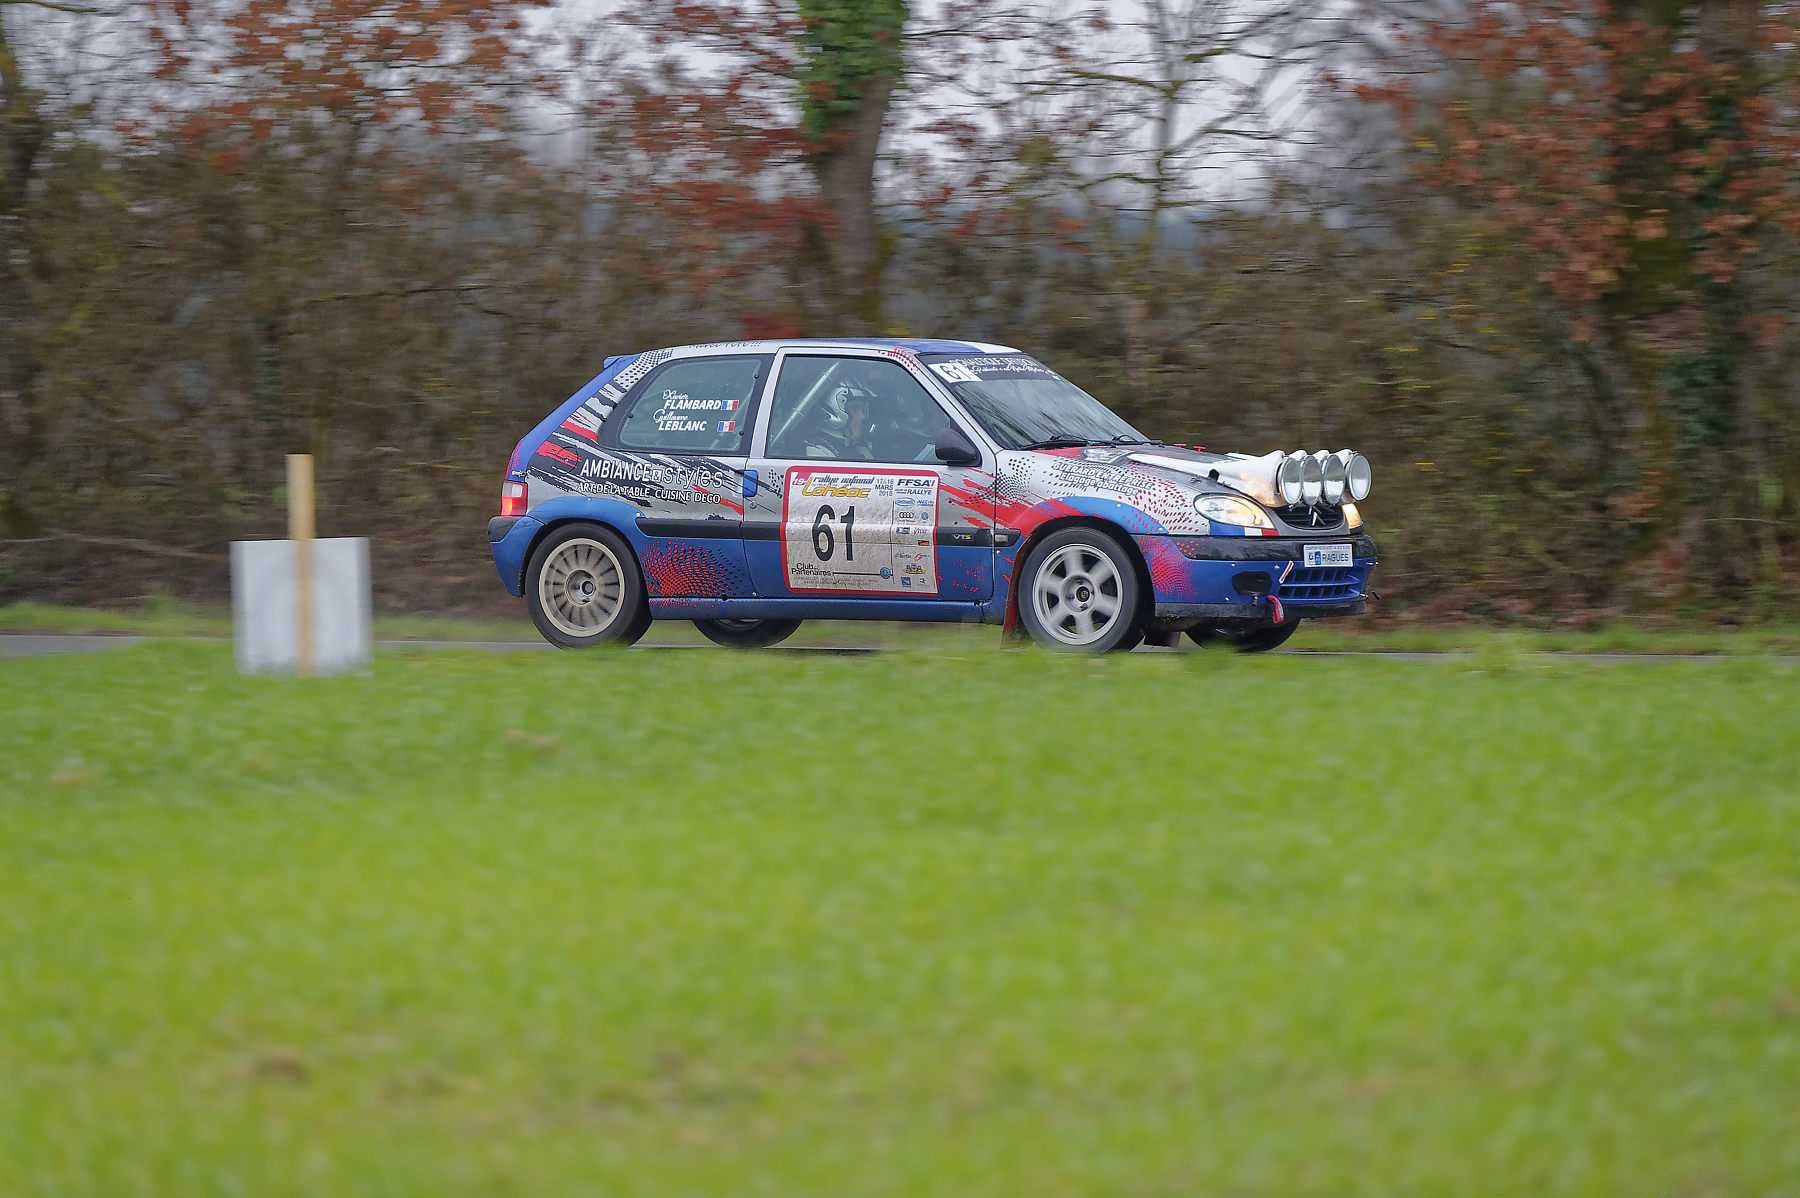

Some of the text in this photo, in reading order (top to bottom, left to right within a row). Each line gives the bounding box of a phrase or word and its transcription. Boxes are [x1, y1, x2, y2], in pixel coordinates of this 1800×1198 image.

[939, 364, 972, 380] 61
[663, 399, 722, 410] FLAMBARD
[658, 421, 708, 431] LEBLANC
[580, 458, 650, 482] AMBIANCE
[662, 466, 723, 490] styles
[813, 476, 875, 486] rallye national
[1053, 462, 1153, 490] GUERARD ENTREPRISE
[802, 476, 872, 498] Lohéac
[897, 478, 931, 487] FFSA
[1060, 473, 1139, 496] Elagage abattage
[655, 489, 691, 501] CUISINE
[694, 492, 721, 504] DECO
[812, 504, 855, 562] 61
[791, 567, 831, 576] Partenaires
[796, 562, 814, 570] Club
